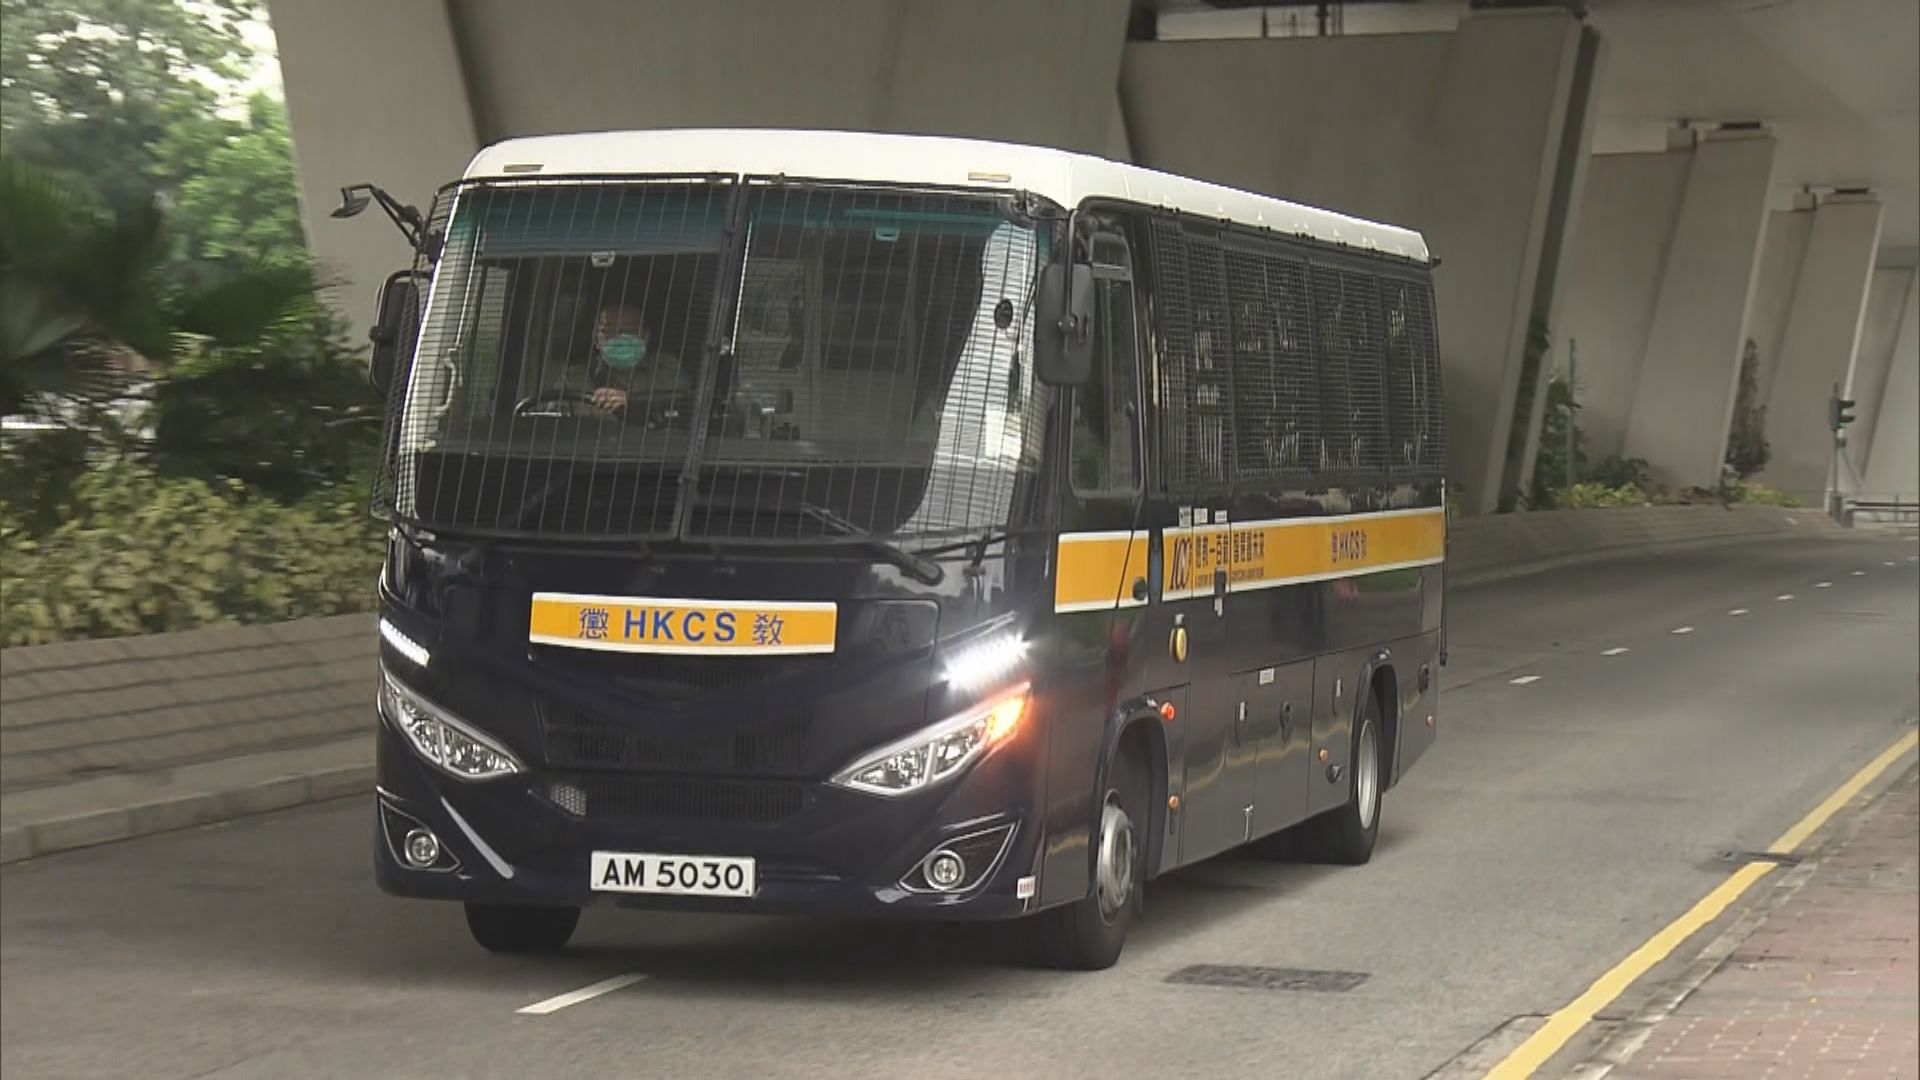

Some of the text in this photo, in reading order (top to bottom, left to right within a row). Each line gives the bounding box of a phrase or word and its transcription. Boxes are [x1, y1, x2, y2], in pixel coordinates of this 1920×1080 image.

[624, 608, 736, 642] HKCS
[602, 858, 744, 890] AM 5030
